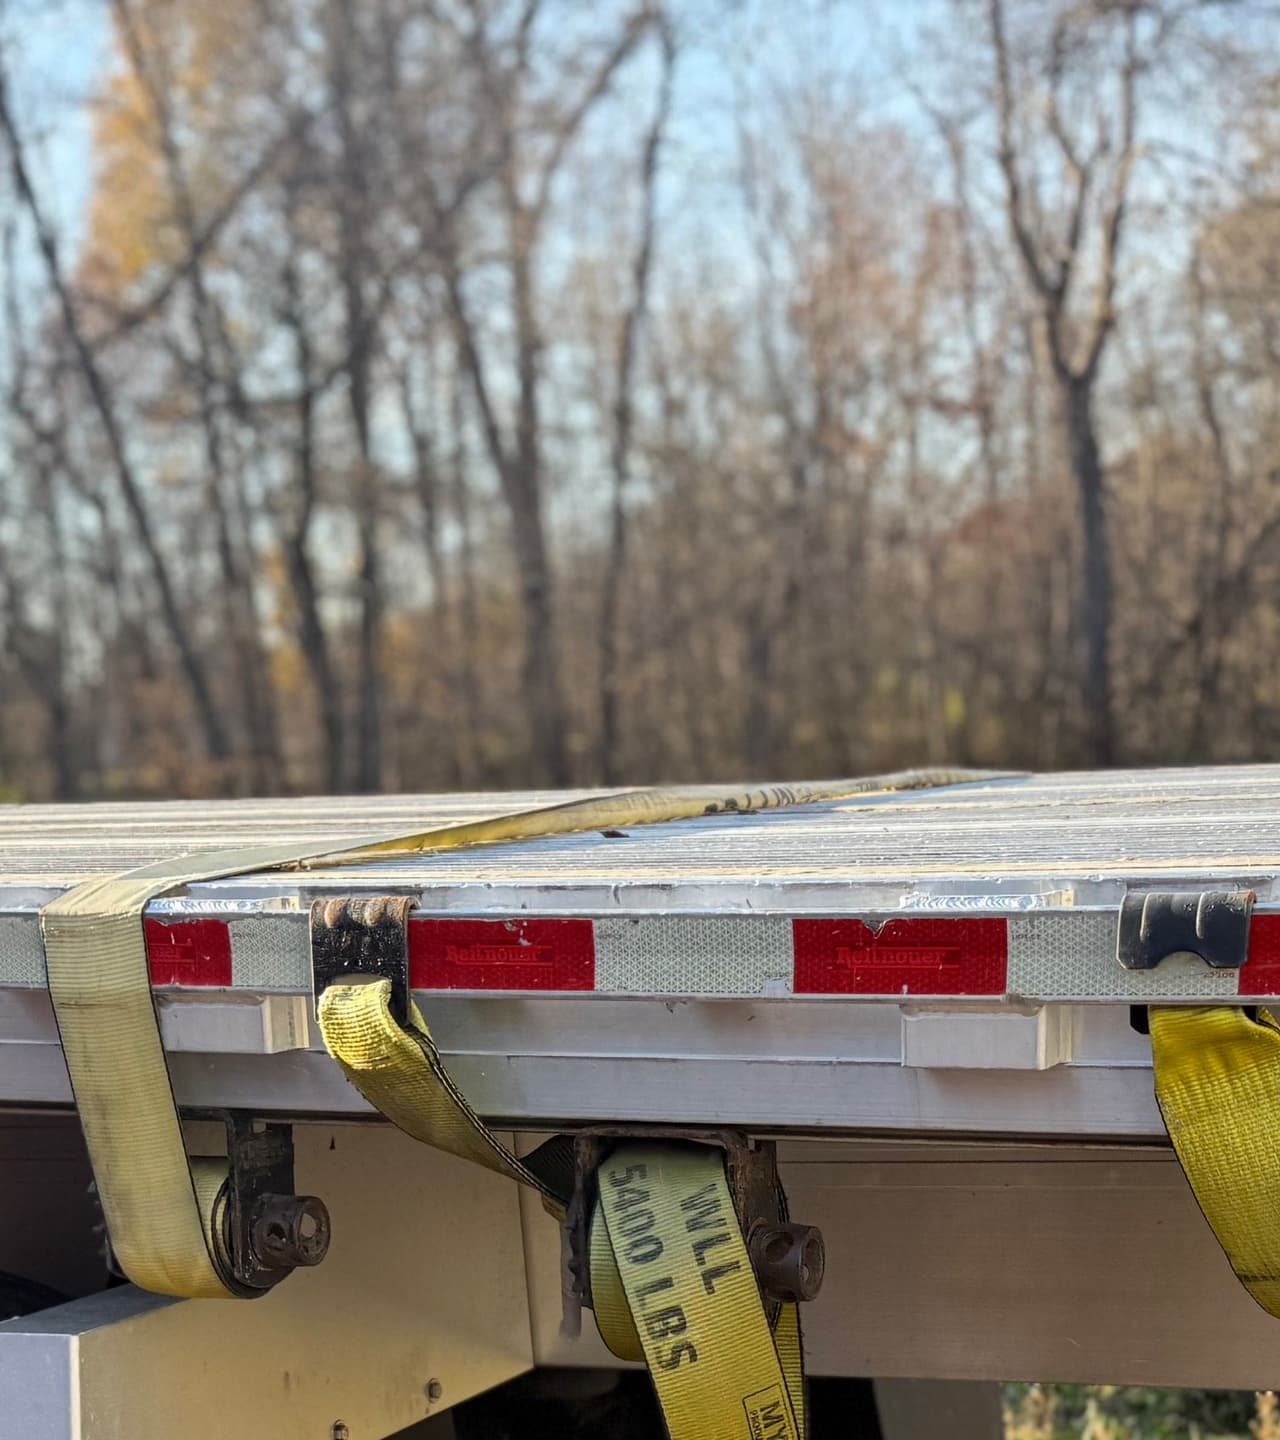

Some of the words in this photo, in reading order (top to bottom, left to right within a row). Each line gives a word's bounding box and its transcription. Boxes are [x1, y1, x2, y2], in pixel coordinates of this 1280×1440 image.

[608, 1164, 664, 1265] 5400
[680, 1183, 742, 1295] WLL
[634, 1277, 698, 1371] LBS
